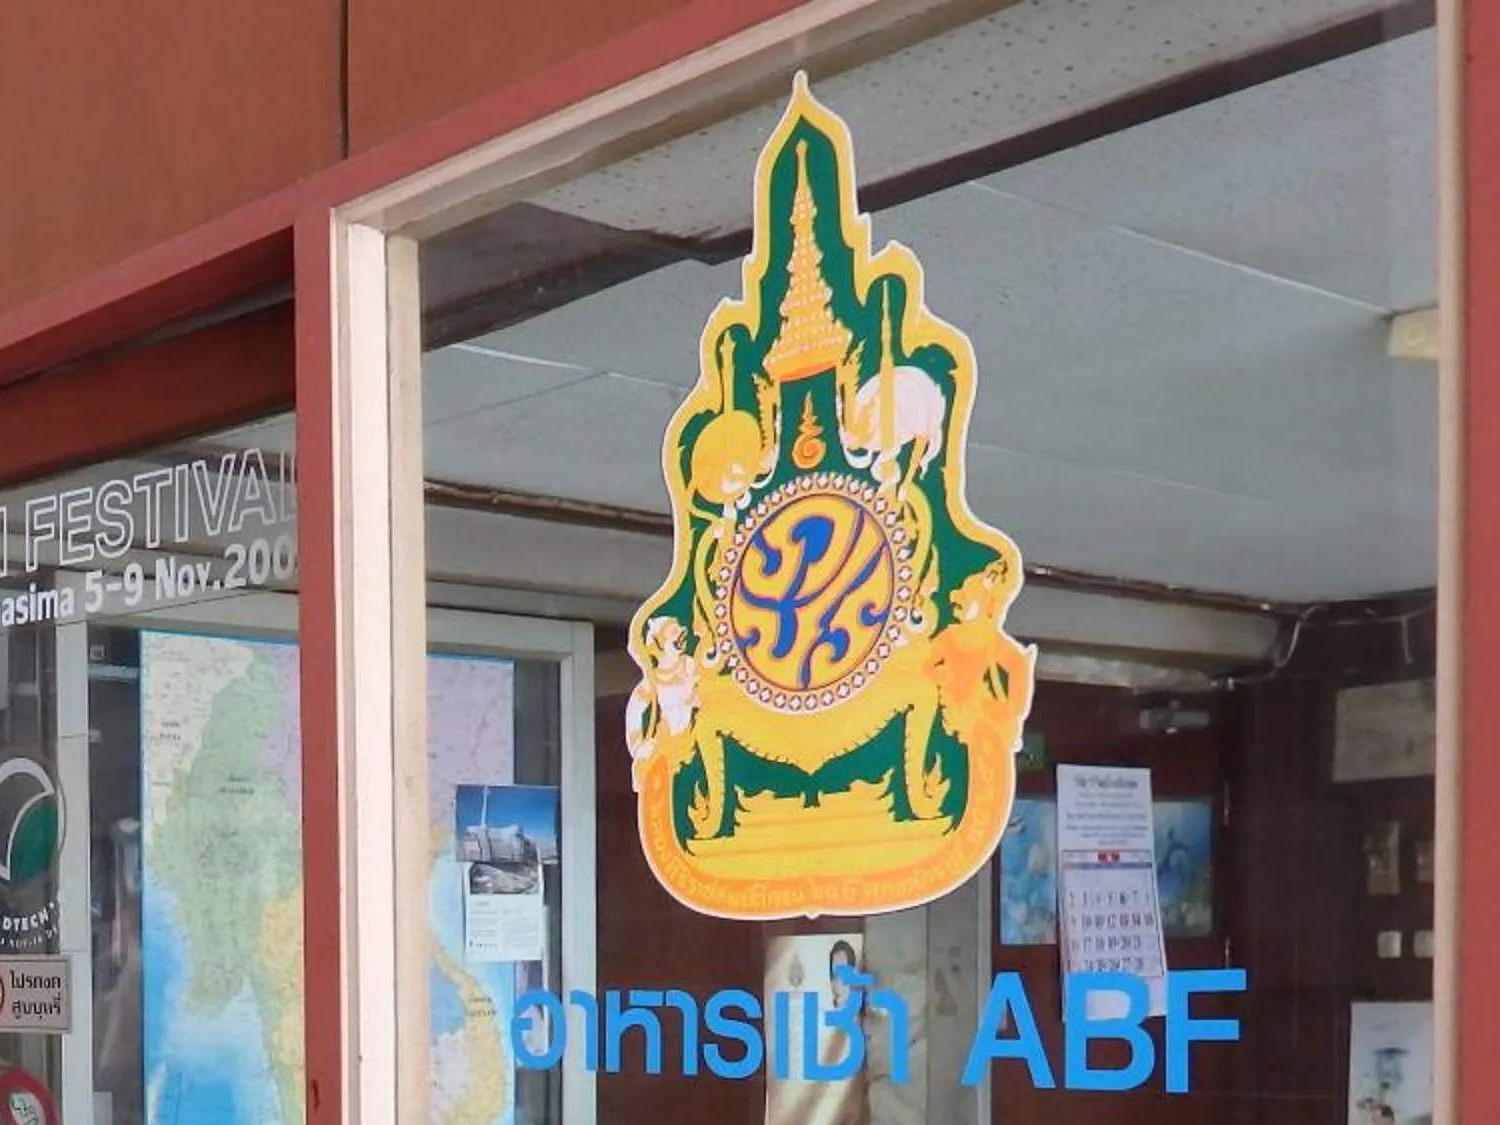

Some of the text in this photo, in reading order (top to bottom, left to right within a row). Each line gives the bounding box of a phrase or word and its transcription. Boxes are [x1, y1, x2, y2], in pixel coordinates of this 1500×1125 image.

[84, 563, 143, 613] 5-9
[509, 964, 1247, 1094] อาหารเช้า ABF
